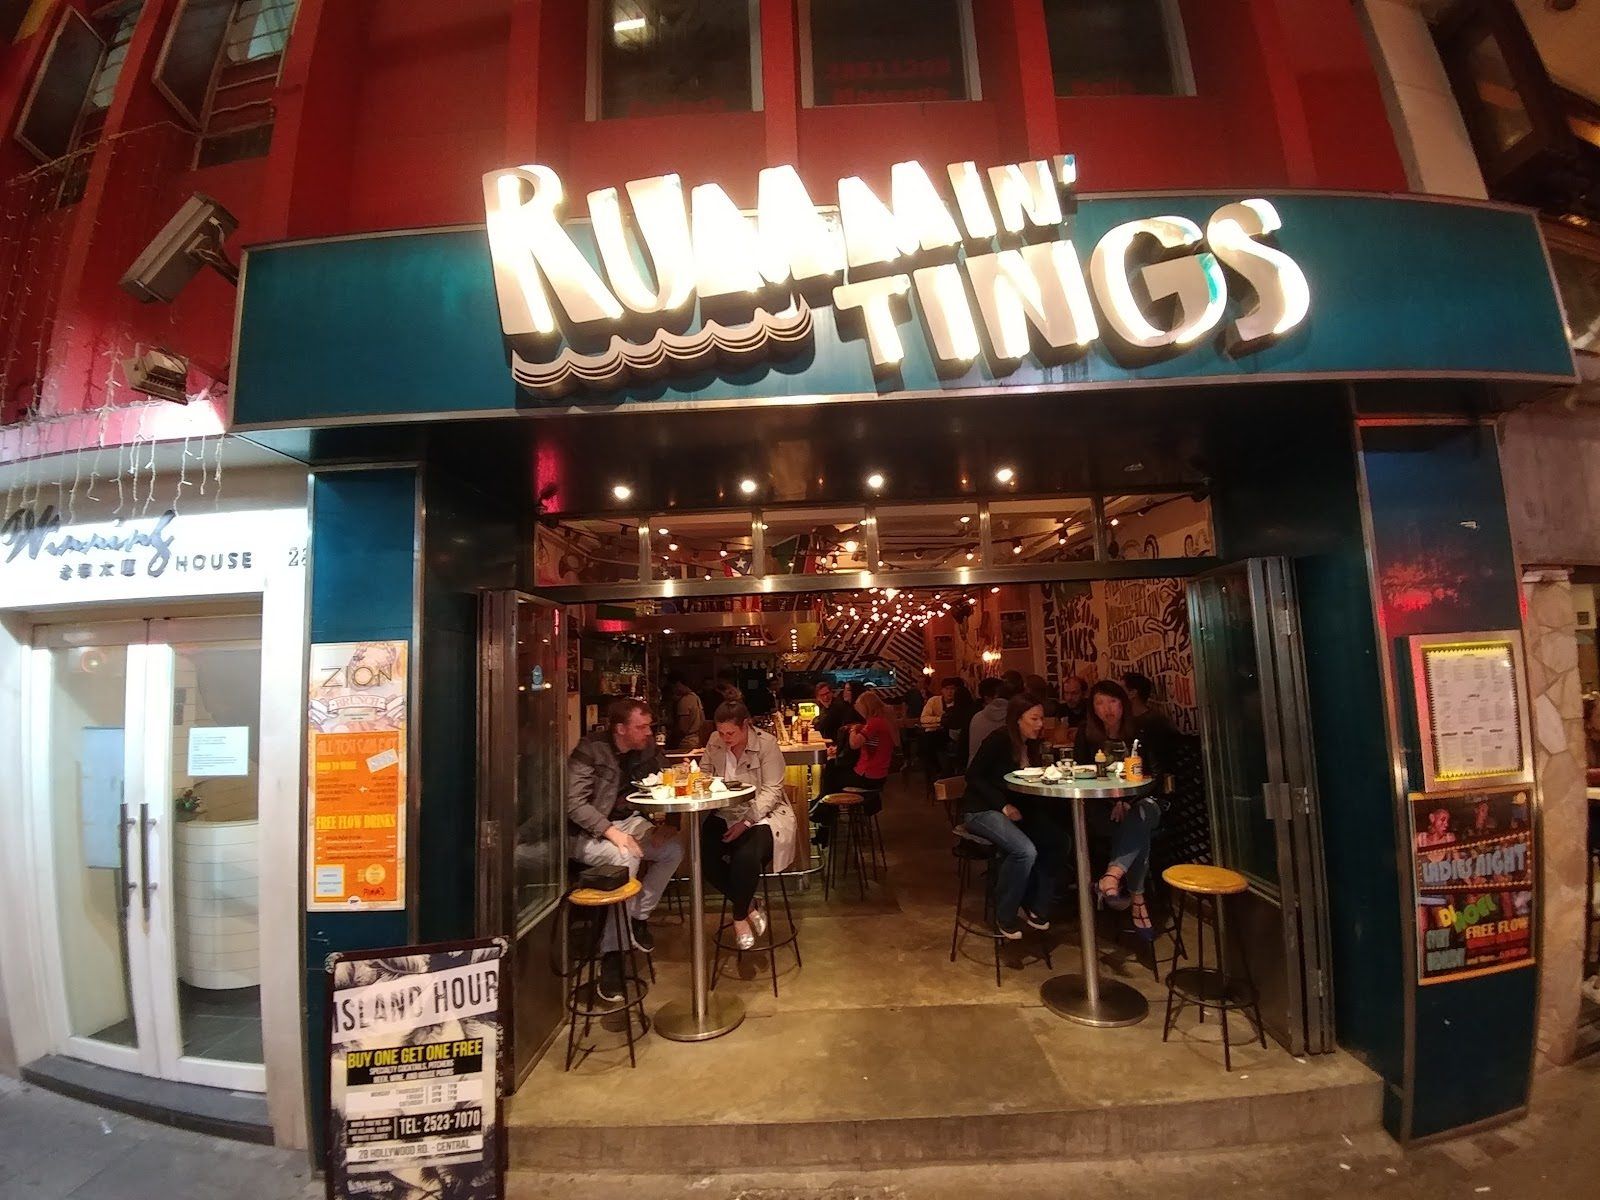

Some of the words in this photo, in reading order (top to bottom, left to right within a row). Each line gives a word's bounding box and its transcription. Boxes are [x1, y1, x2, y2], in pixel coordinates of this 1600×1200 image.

[483, 153, 1077, 336] RUMMIN'
[833, 199, 1312, 368] TINGS
[175, 551, 252, 572] HOUSE
[321, 663, 392, 689] ZION
[336, 696, 379, 709] BRUNCH
[317, 815, 337, 829] FREE
[339, 814, 362, 829] FLOW
[364, 813, 396, 828] DRINKS
[1475, 843, 1527, 877] NIGHT
[1466, 922, 1496, 939] FREE
[1498, 916, 1529, 935] FLOW
[333, 984, 423, 1034] ISLAND
[434, 970, 498, 1015] HOUR
[348, 1051, 373, 1069] BUY
[374, 1048, 399, 1066] ONE
[401, 1045, 424, 1063] GET
[426, 1043, 451, 1061] ONE
[453, 1039, 482, 1058] FREE
[399, 1118, 421, 1135] TEL:
[423, 1110, 481, 1132] 2523-7070
[370, 1146, 415, 1158] HOLLYWOOD
[436, 1139, 470, 1152] CENTRAL
